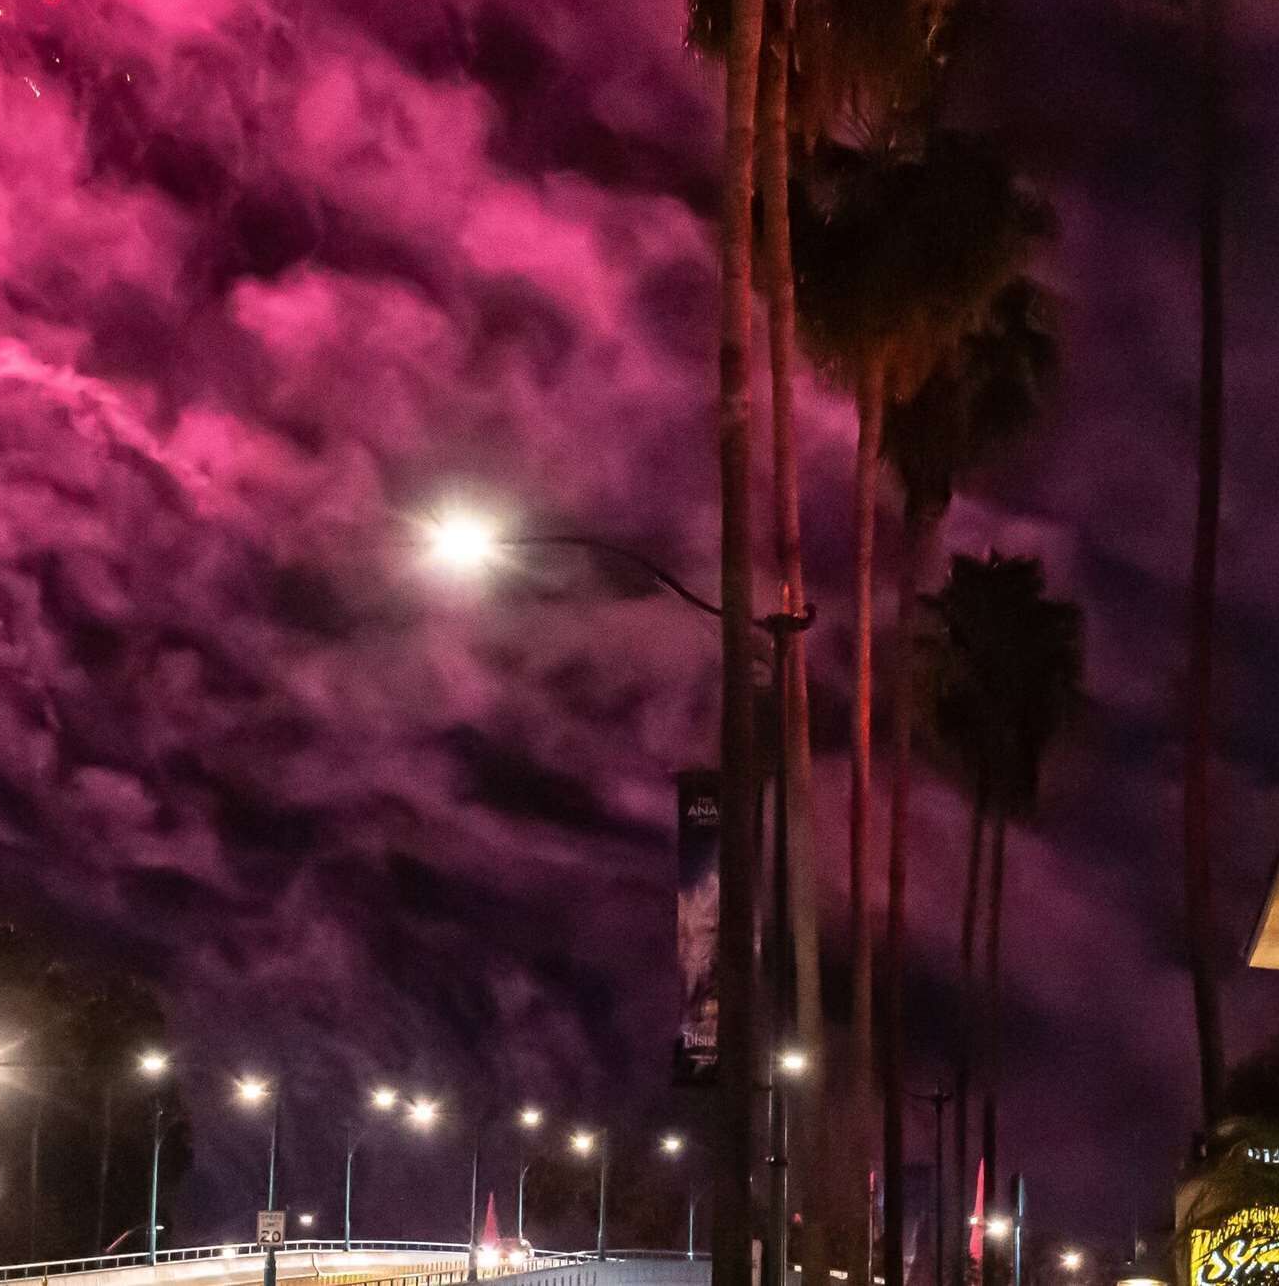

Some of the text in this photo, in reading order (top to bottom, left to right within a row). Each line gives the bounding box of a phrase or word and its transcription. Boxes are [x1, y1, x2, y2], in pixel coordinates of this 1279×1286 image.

[688, 805, 719, 816] ANA
[683, 1032, 718, 1050] Disne
[260, 1230, 282, 1243] 20
